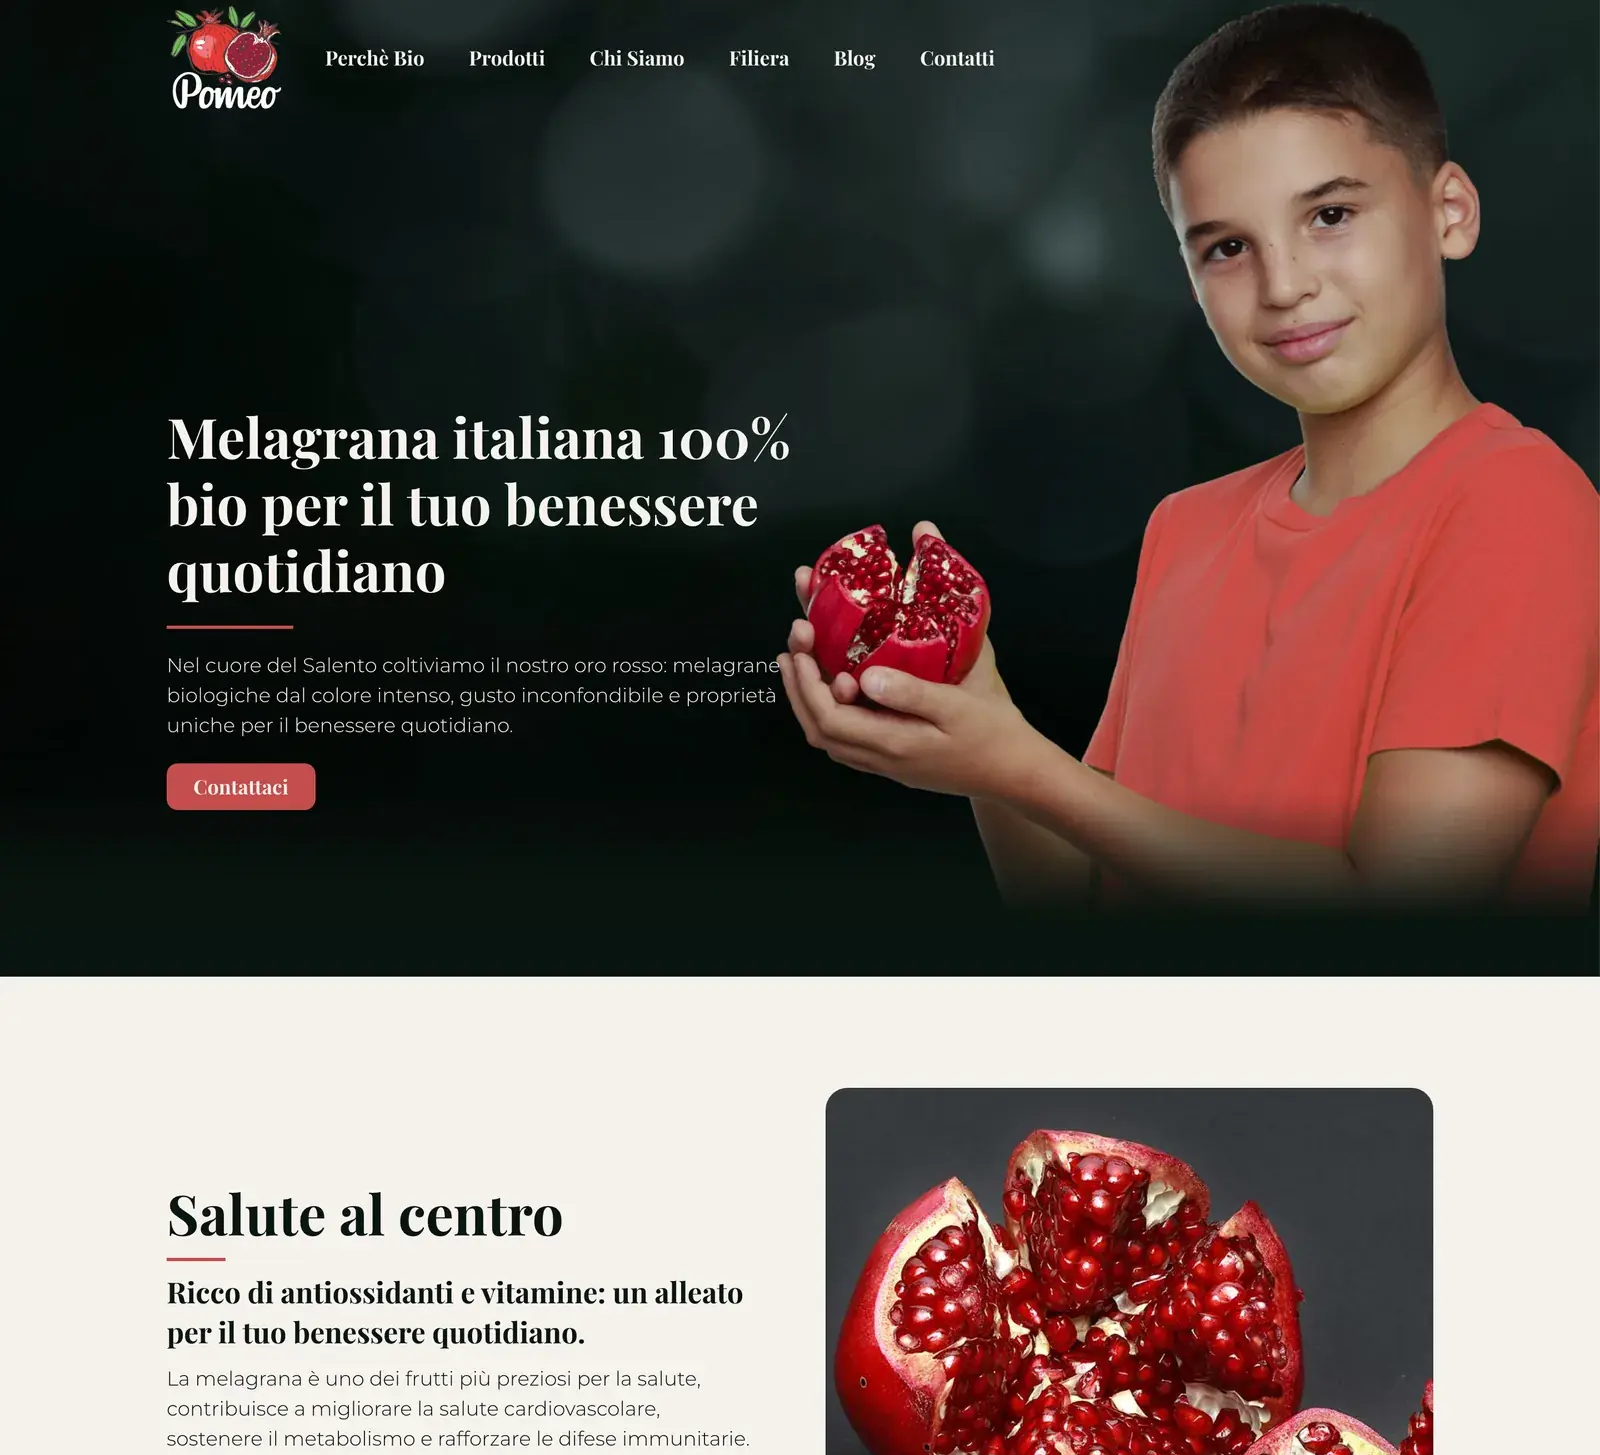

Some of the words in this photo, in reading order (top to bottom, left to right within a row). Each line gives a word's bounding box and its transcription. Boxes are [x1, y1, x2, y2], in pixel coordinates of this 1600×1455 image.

[325, 48, 389, 67] Perchè
[393, 49, 425, 67] Bio
[469, 49, 546, 67] Prodotti
[589, 49, 623, 67] Chi
[627, 49, 685, 67] Siamo
[729, 49, 790, 67] Filiera
[834, 49, 877, 71] Blog
[920, 49, 995, 67] Contatti
[172, 71, 281, 109] Pomeo
[167, 414, 440, 471] Melagrana
[452, 414, 645, 461] italiana
[658, 412, 790, 463] 100%
[166, 481, 247, 528] bio
[261, 495, 349, 537] per
[360, 481, 394, 527] il
[406, 487, 491, 528] tuo
[504, 481, 758, 528] benessere
[168, 548, 445, 603] quotidiano
[168, 656, 199, 674] Nel
[205, 660, 262, 674] cuore
[267, 656, 297, 674] del
[303, 656, 377, 674] Salento
[382, 656, 485, 674] coltiviamo
[491, 656, 500, 673] il
[506, 658, 569, 674] nostro
[574, 660, 607, 674] oro
[612, 660, 667, 674] rosso:
[674, 656, 781, 677] melagrane
[193, 778, 289, 796] Contattaci
[168, 1191, 325, 1238] Salute
[340, 1191, 385, 1237] al
[399, 1197, 563, 1238] centro
[167, 1280, 241, 1305] Ricco
[247, 1280, 274, 1305] di
[280, 1280, 454, 1305] antiossidanti
[461, 1287, 475, 1305] e
[480, 1280, 605, 1305] vitamine:
[612, 1287, 648, 1305] un
[654, 1280, 743, 1305] alleato
[166, 1327, 213, 1350] per
[218, 1320, 236, 1345] il
[242, 1323, 287, 1345] tuo
[292, 1320, 426, 1345] benessere
[432, 1320, 585, 1350] quotidiano.
